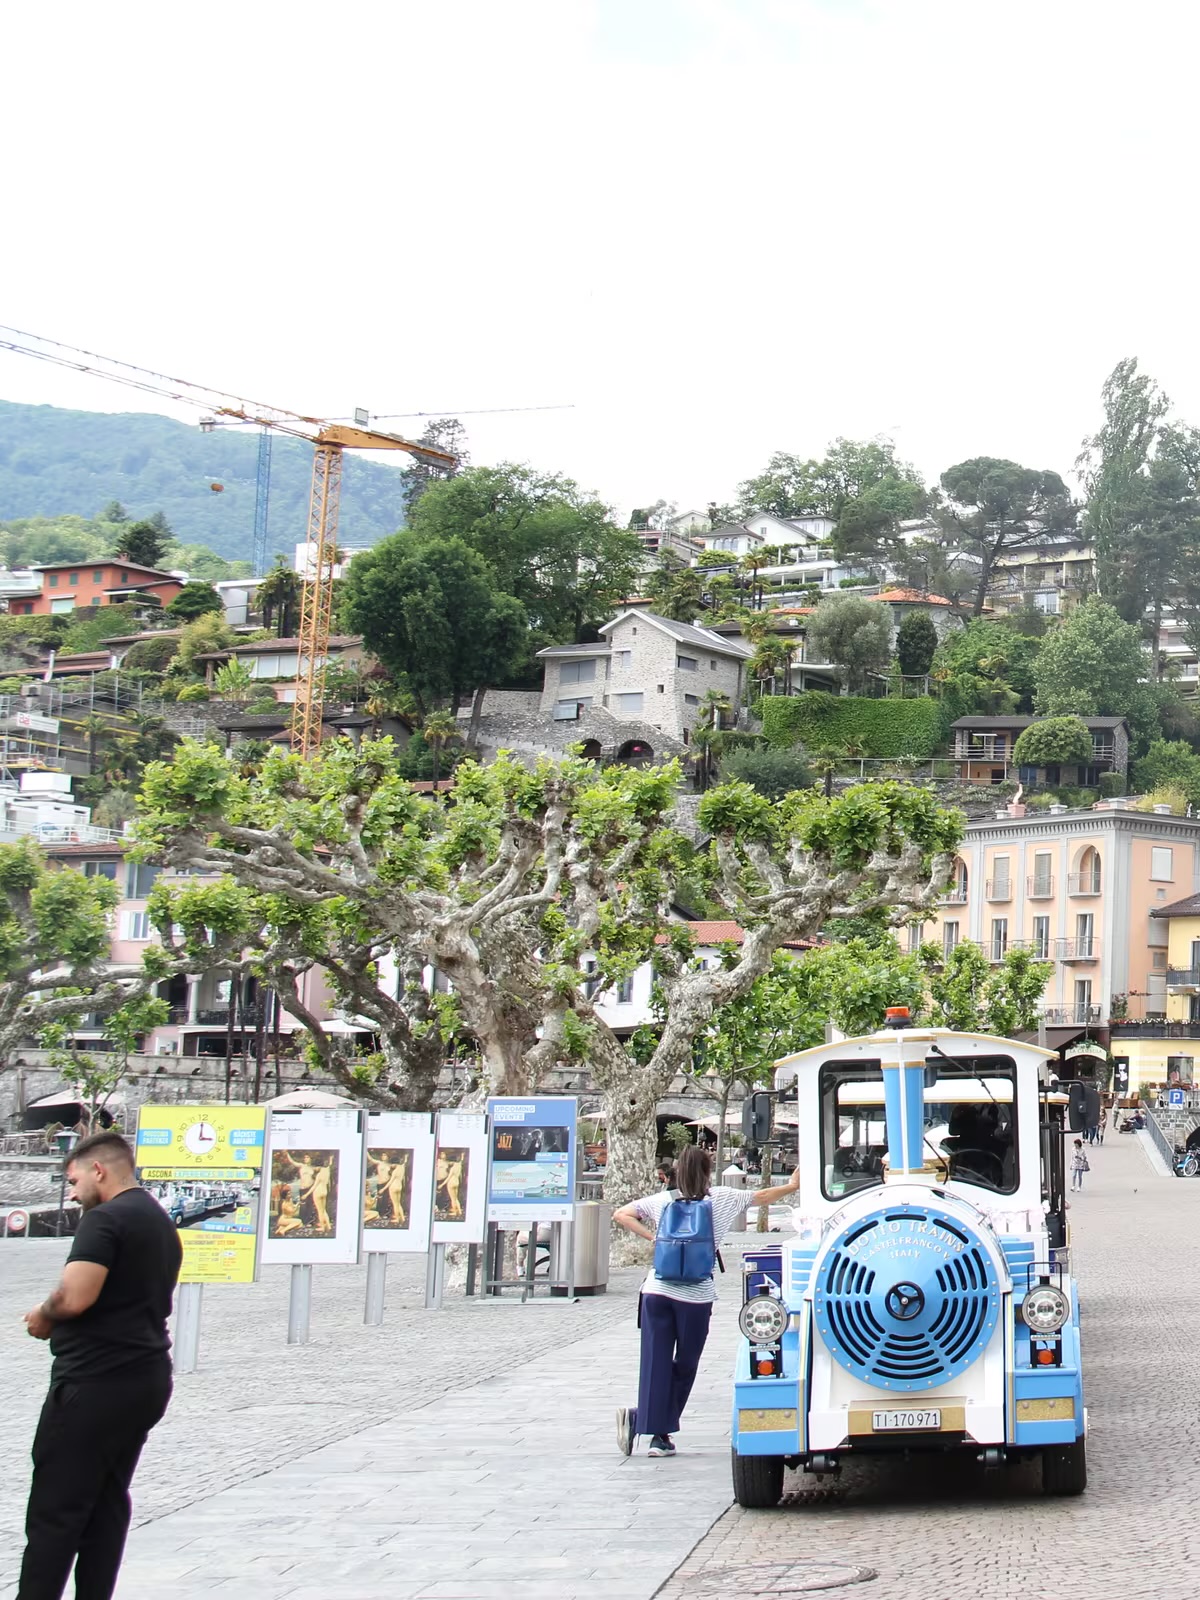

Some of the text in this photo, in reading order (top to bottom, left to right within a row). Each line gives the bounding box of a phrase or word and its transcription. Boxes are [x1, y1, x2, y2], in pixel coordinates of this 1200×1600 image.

[1173, 1092, 1180, 1103] P
[218, 1135, 225, 1143] 3
[497, 1135, 513, 1149] JAZZ
[195, 1155, 203, 1163] 6
[147, 1170, 172, 1178] ASCONA
[847, 1221, 965, 1256] DOTTO TRAINS
[889, 1249, 921, 1259] ITALY
